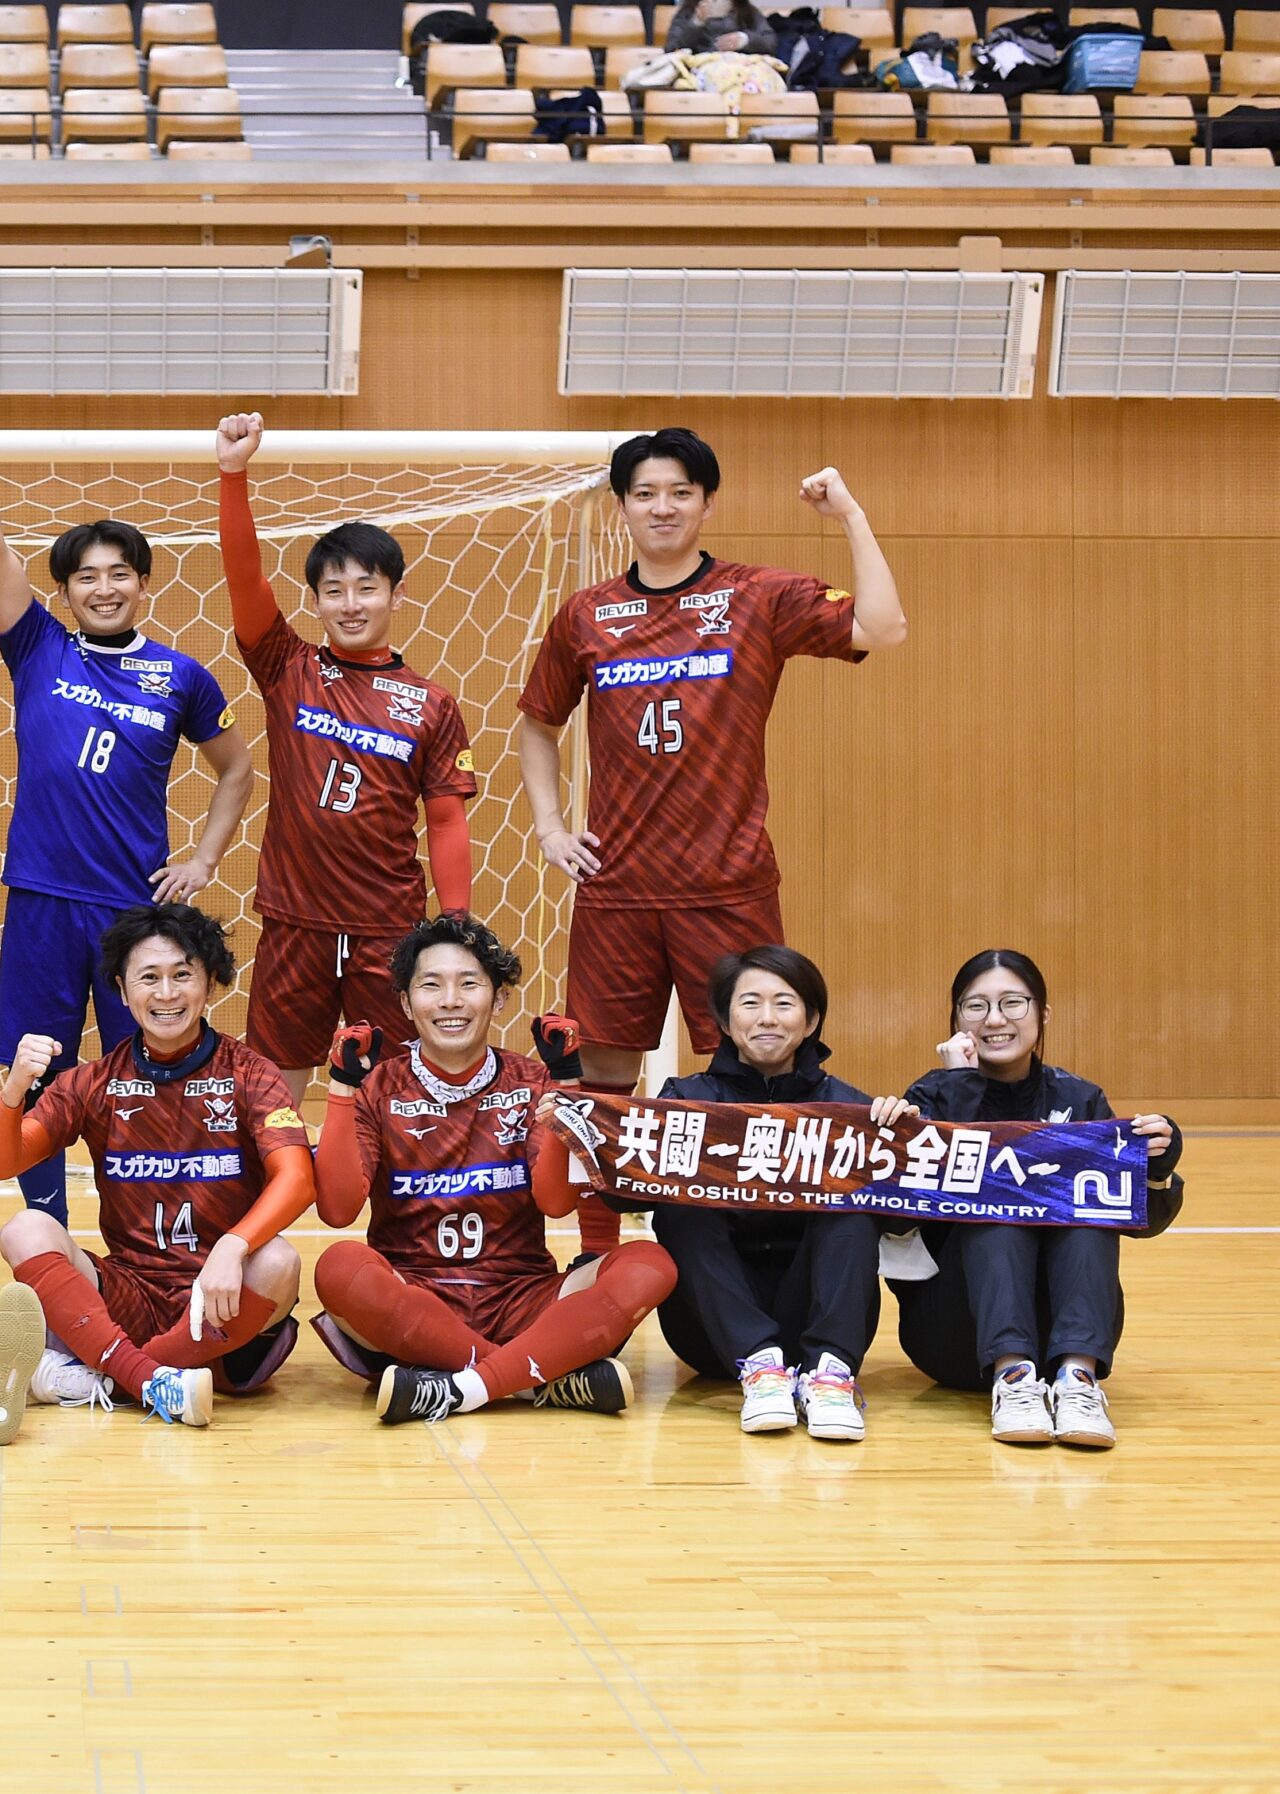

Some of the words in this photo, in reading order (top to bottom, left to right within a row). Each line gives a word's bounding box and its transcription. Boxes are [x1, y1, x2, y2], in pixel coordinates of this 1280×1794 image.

[595, 653, 729, 688] スガカツ不動産
[76, 725, 118, 774] 18
[296, 707, 414, 763] スガカツ不動産
[637, 698, 684, 755] 45
[318, 758, 362, 814] 13
[105, 1153, 242, 1179] スガカツ不動産
[392, 1164, 527, 1195] スガカツ不動産
[615, 1177, 680, 1197] FROM
[686, 1183, 759, 1202] OSHU
[765, 1190, 795, 1205] TO
[801, 1192, 845, 1205] THE
[849, 1194, 932, 1213] WHOLE
[938, 1201, 1049, 1218] COUNTRY
[154, 1200, 199, 1253] 14
[436, 1211, 485, 1260] 69
